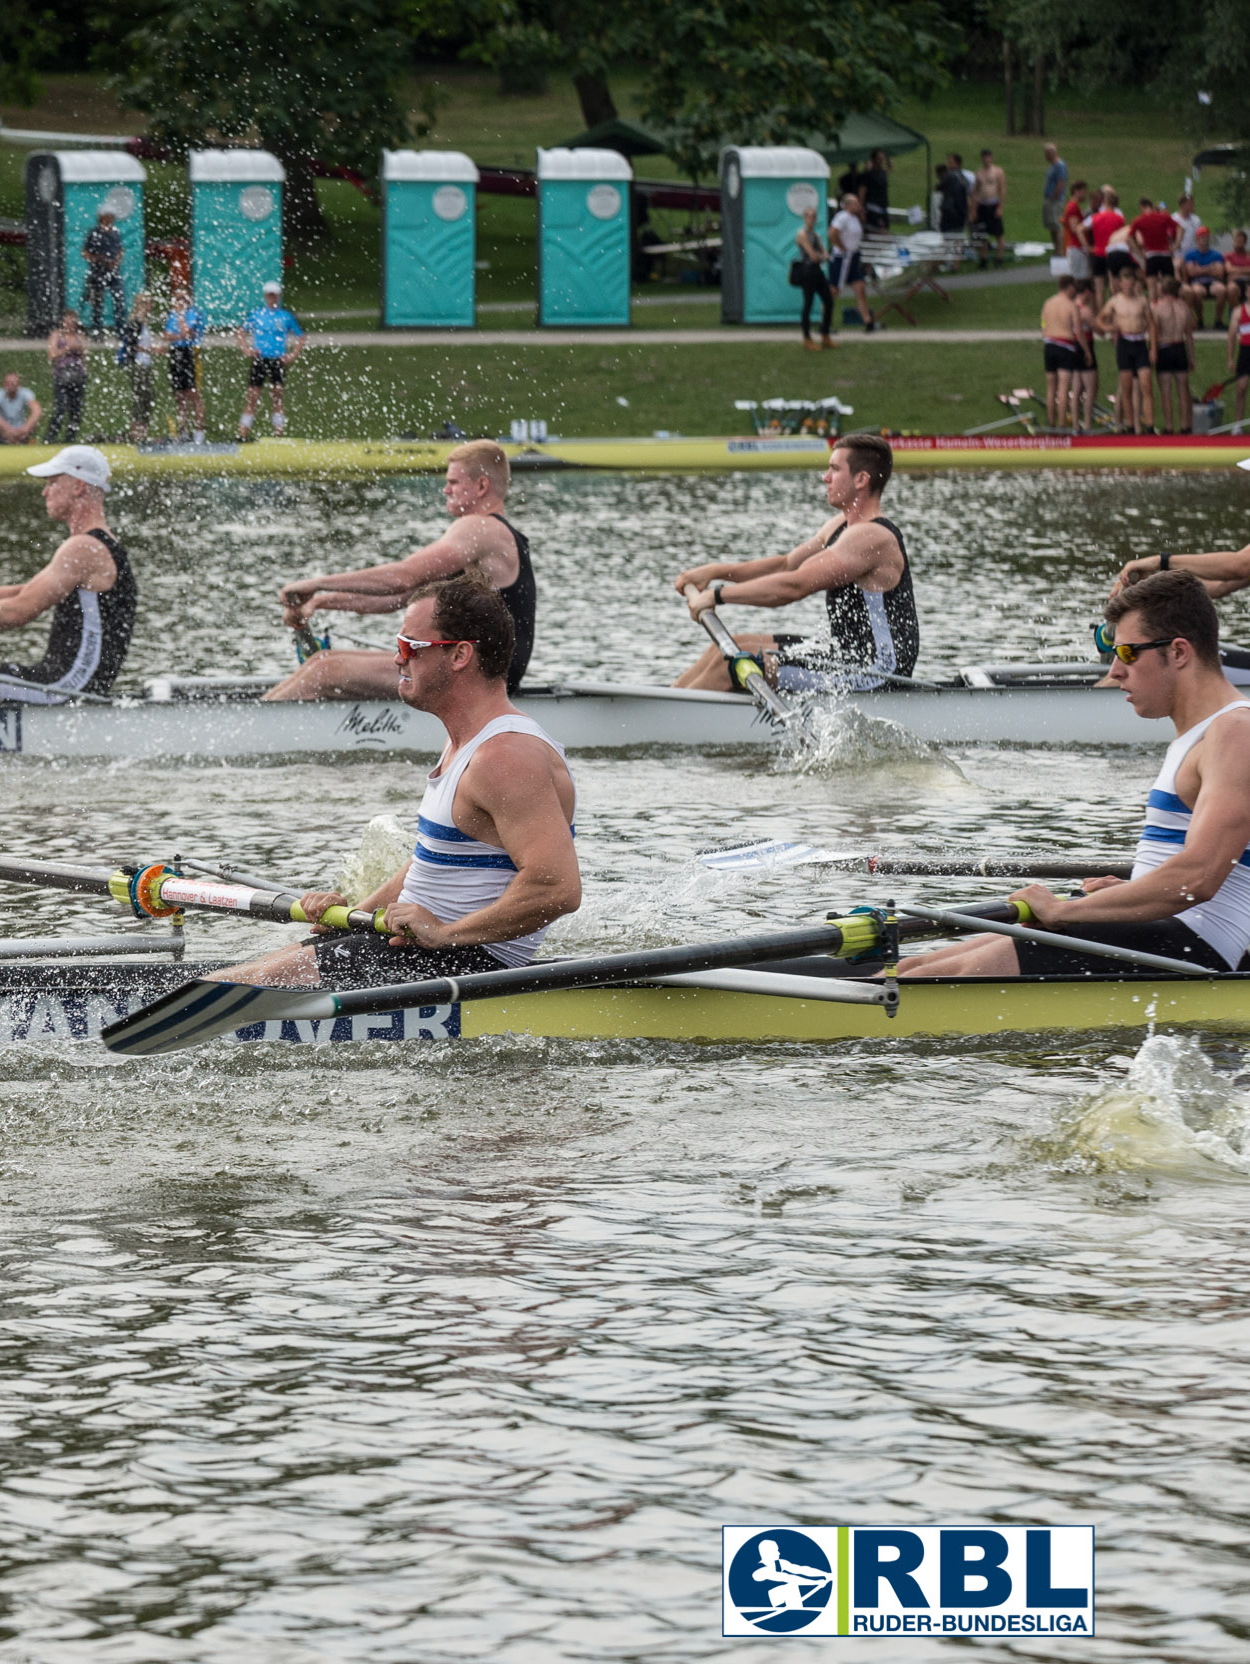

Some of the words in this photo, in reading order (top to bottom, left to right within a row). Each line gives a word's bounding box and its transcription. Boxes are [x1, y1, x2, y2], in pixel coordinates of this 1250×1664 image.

[334, 704, 404, 735] Melitta
[162, 887, 199, 902] Hannover
[200, 891, 207, 904] &
[208, 892, 238, 907] Laatzen
